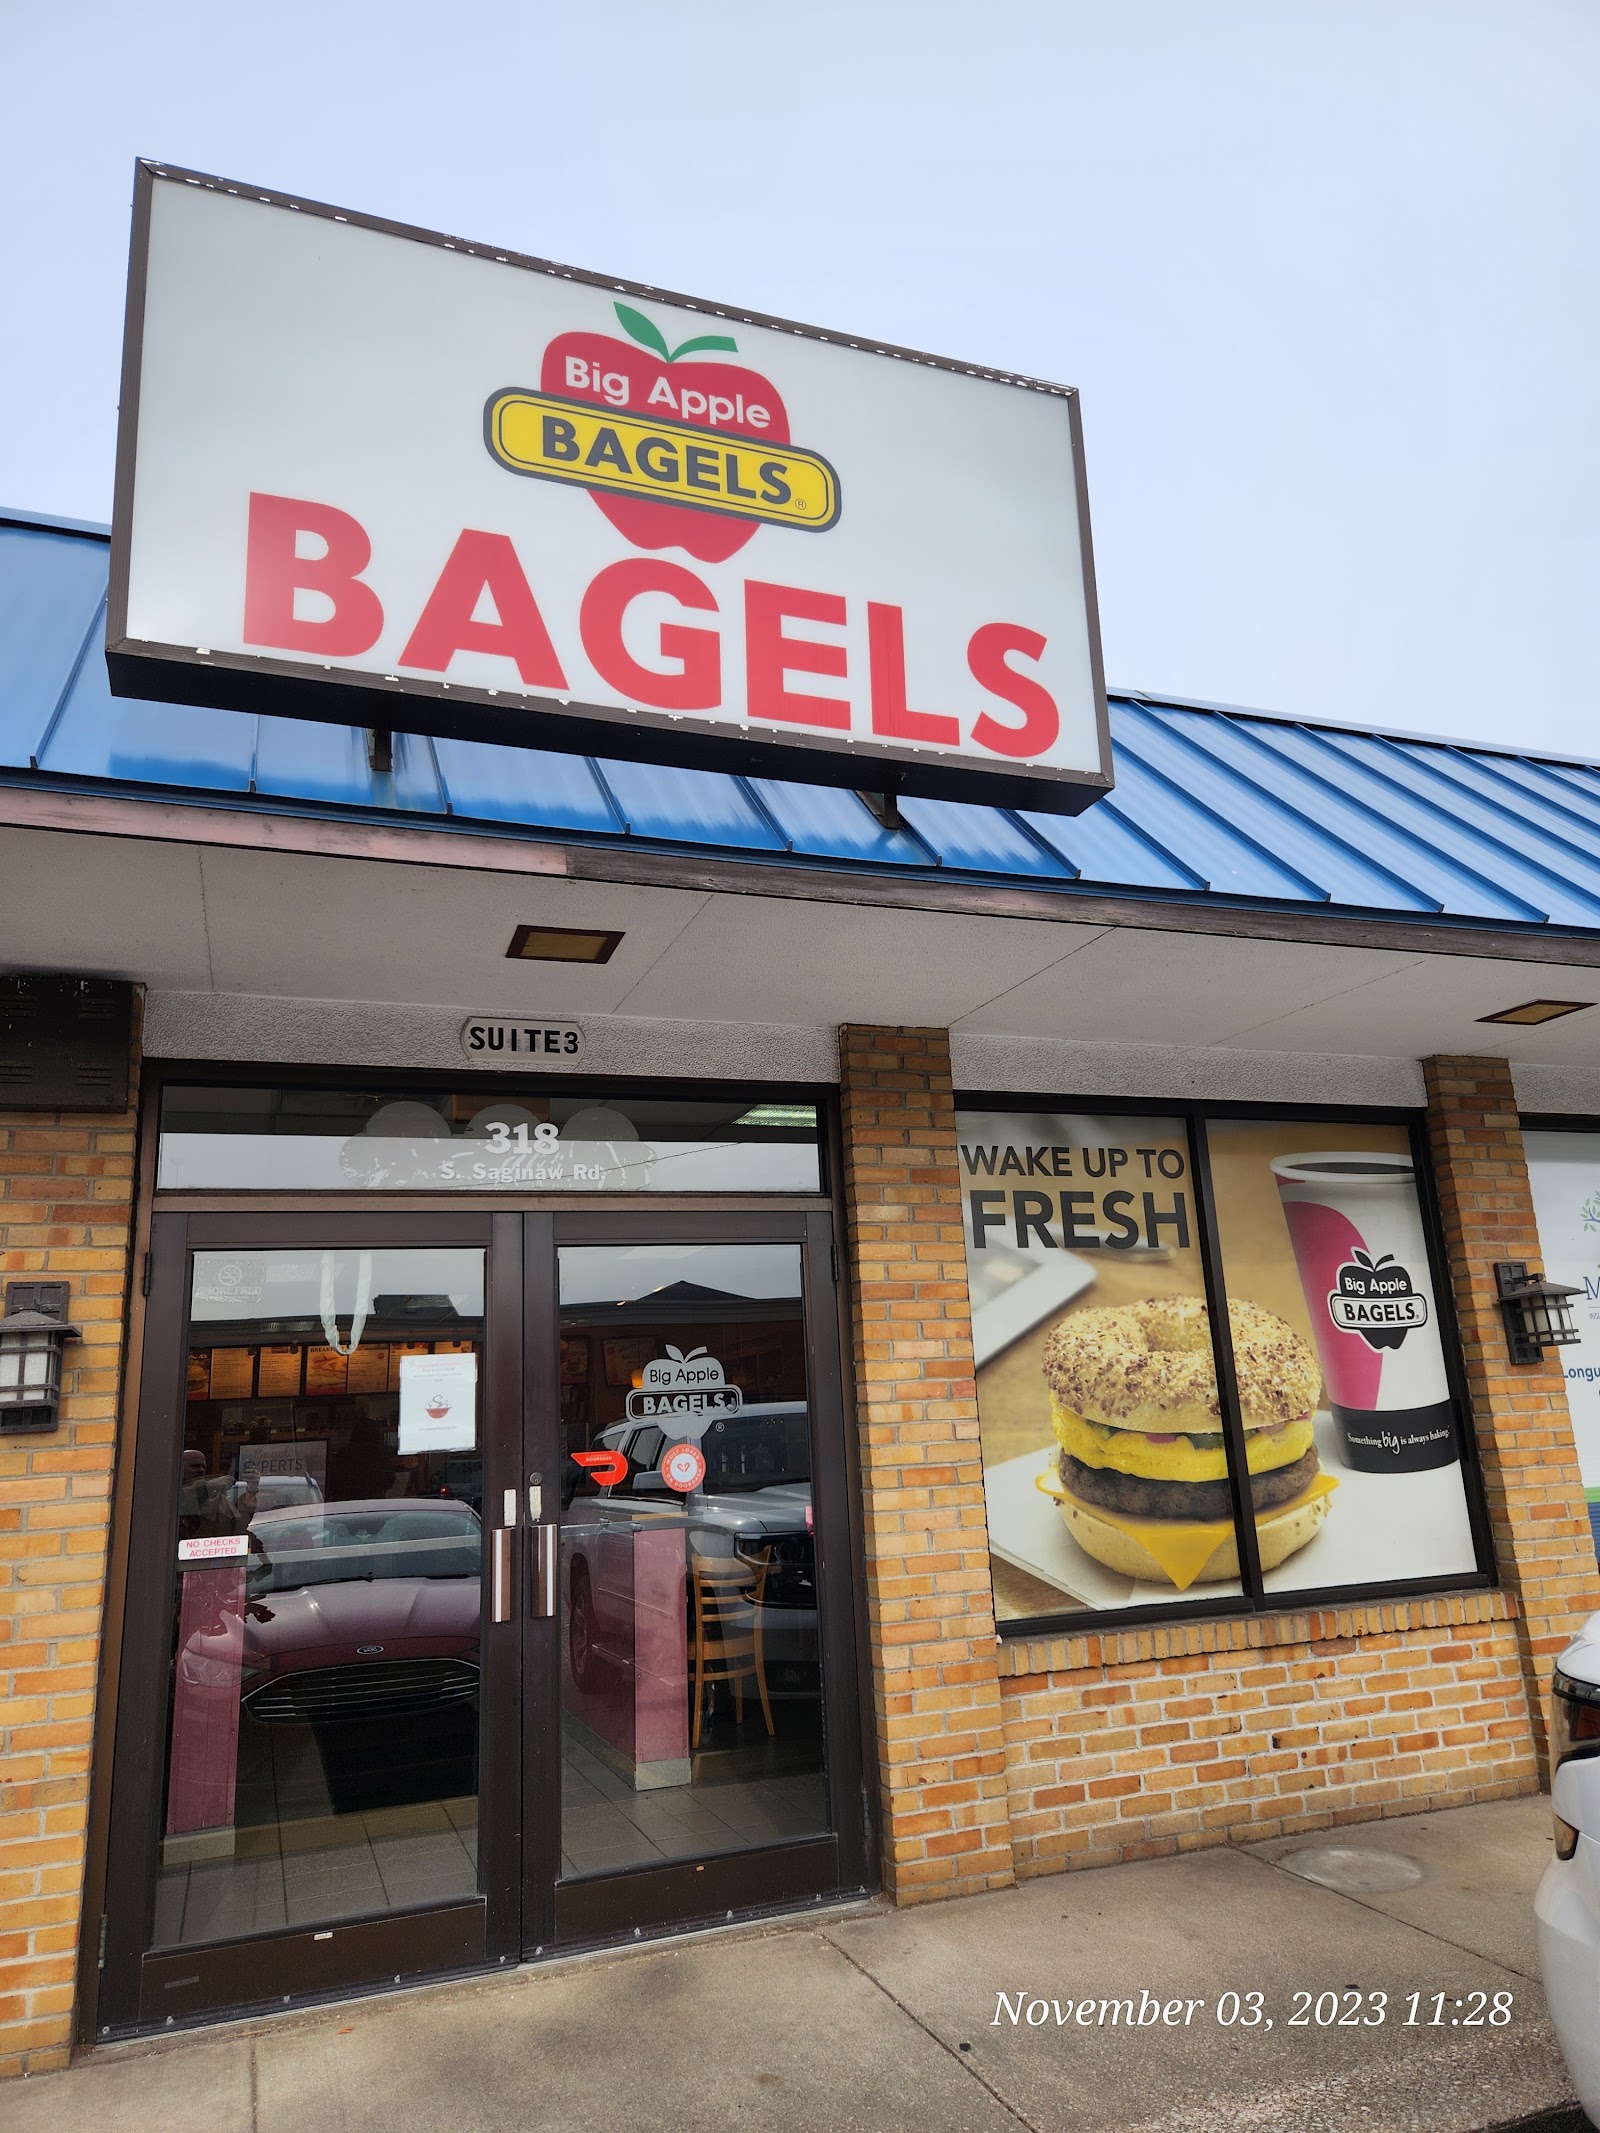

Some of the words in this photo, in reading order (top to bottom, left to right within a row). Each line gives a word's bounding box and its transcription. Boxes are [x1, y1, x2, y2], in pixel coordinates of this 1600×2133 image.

[565, 355, 629, 406] Big
[647, 376, 771, 429] Apple
[542, 415, 792, 505] BAGELS
[243, 492, 1059, 758] BAGELS
[484, 1122, 560, 1155] 318
[960, 1145, 1072, 1177] WAKE
[1083, 1147, 1128, 1178] UP
[1136, 1148, 1185, 1179] TO
[472, 1163, 564, 1183] Saginaw
[573, 1163, 606, 1180] Rd.
[969, 1190, 1191, 1249] FRESH
[1344, 1277, 1366, 1295] Big
[1370, 1278, 1408, 1295] Apple
[1343, 1302, 1415, 1322] BAGELS
[649, 1369, 671, 1385] Big
[675, 1367, 720, 1384] Apple
[643, 1393, 726, 1415] BAGELS
[1347, 1432, 1383, 1449] Something
[1381, 1430, 1400, 1454] big
[1400, 1436, 1407, 1445] is
[1407, 1434, 1430, 1445] always
[666, 1448, 680, 1465] MOST
[681, 1447, 701, 1461] LOVED
[243, 1459, 303, 1475] EXPERTS
[189, 1547, 237, 1557] ACCEPTED
[203, 1537, 241, 1547] CHECKS
